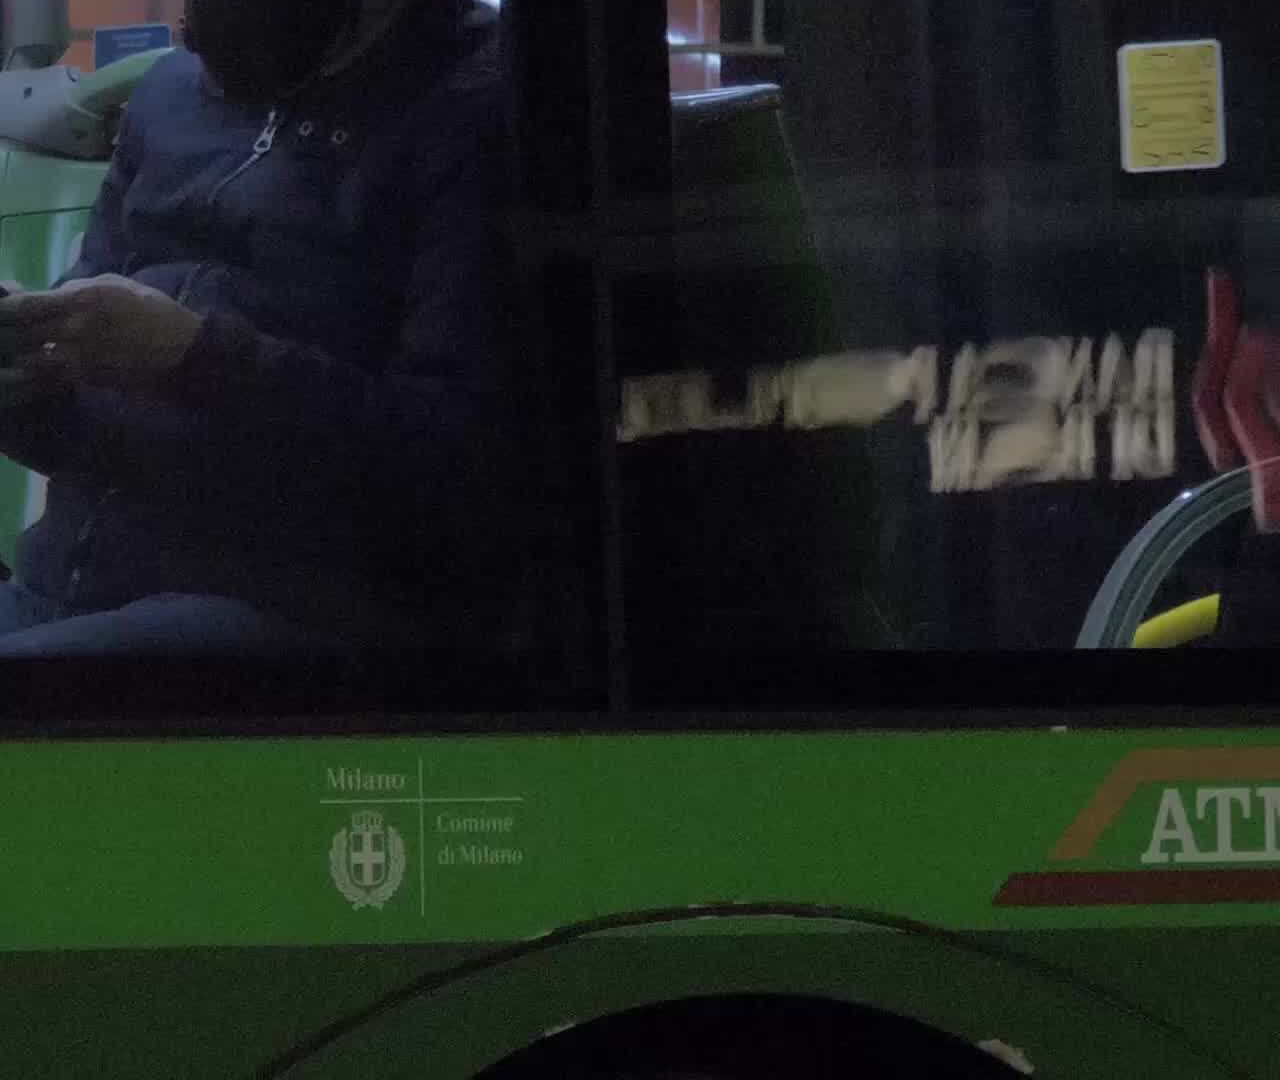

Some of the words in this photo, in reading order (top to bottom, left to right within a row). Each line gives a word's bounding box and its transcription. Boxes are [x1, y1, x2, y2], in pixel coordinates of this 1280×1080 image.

[327, 767, 407, 792] Milano
[436, 814, 514, 834] Comune
[437, 845, 455, 865] di
[457, 844, 525, 865] Milano
